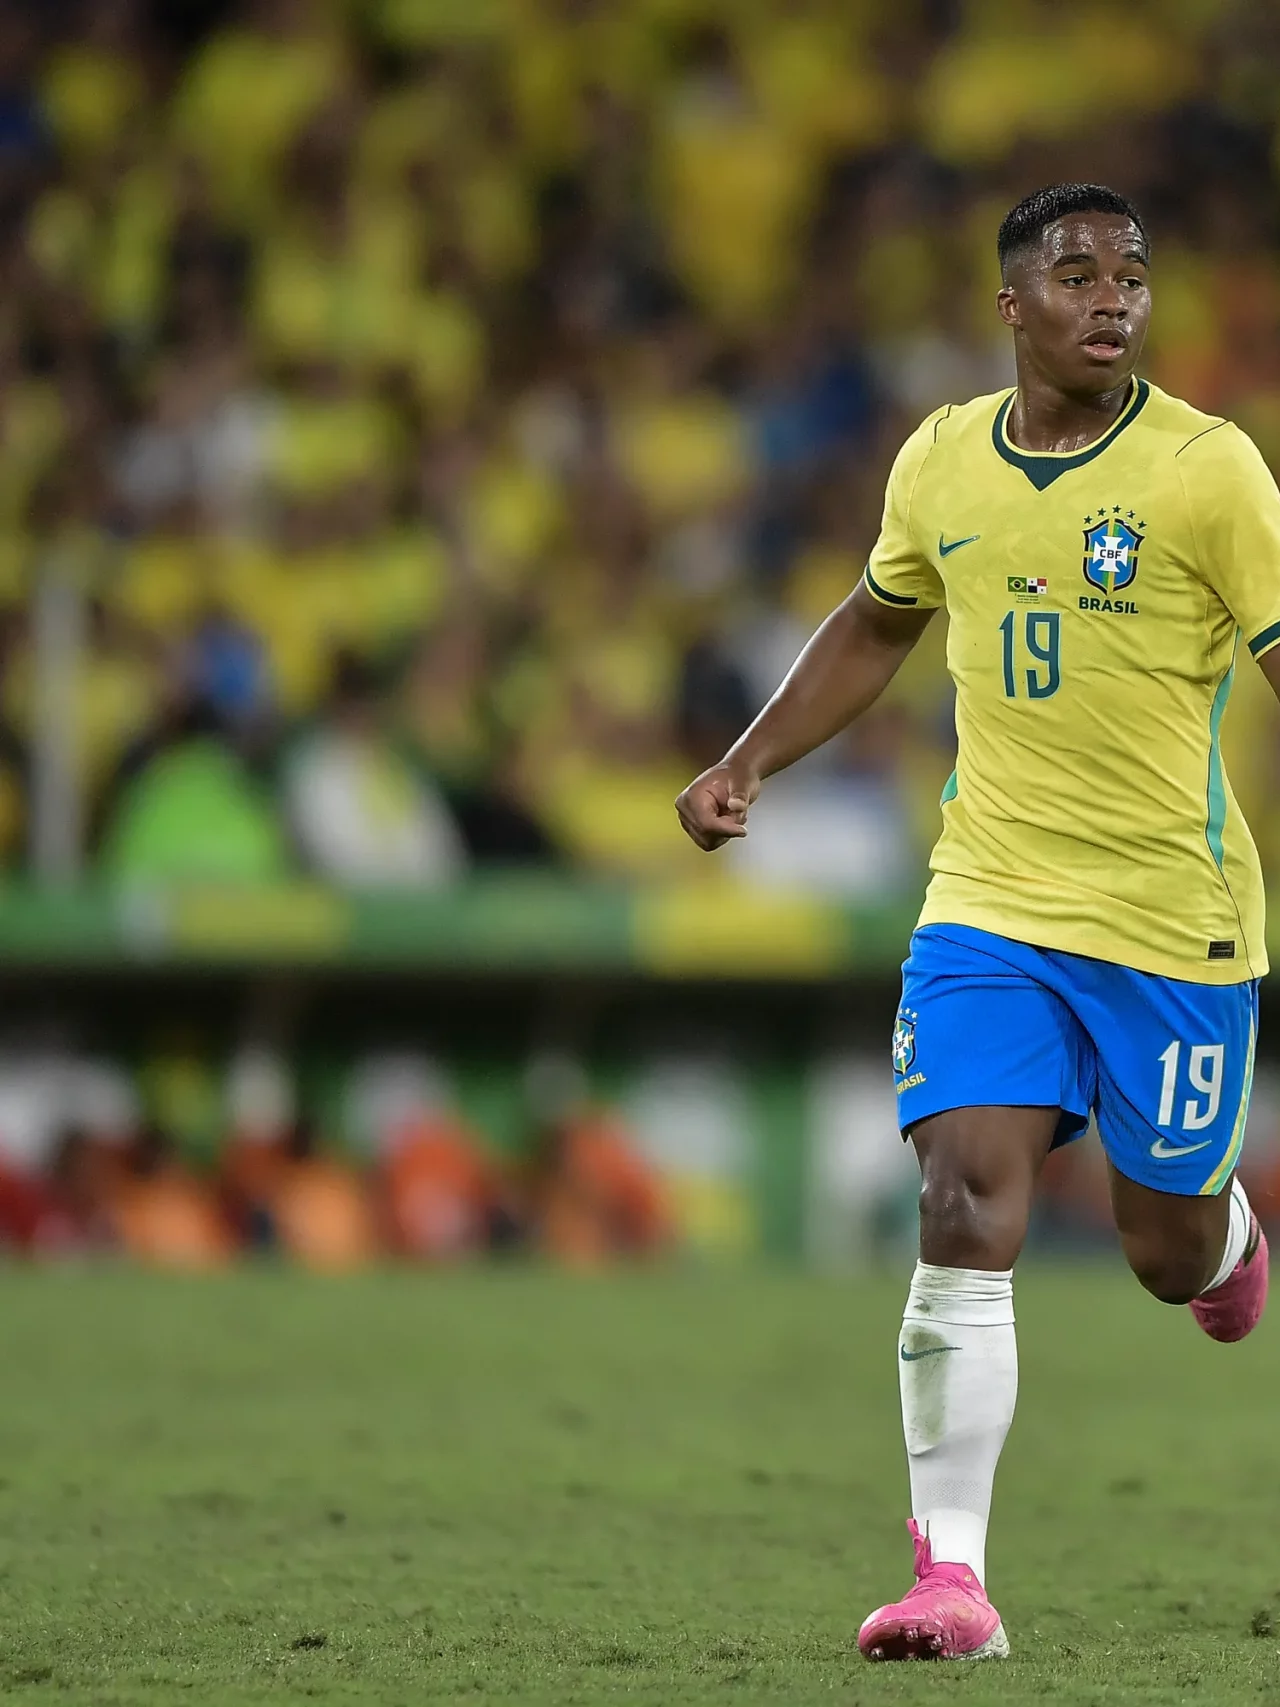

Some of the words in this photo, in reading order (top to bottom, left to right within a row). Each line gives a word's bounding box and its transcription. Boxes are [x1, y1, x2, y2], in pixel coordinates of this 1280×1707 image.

[1100, 549, 1122, 559] CBF
[1079, 596, 1139, 614] BRASIL
[998, 609, 1061, 699] 19
[1157, 1039, 1224, 1130] 19
